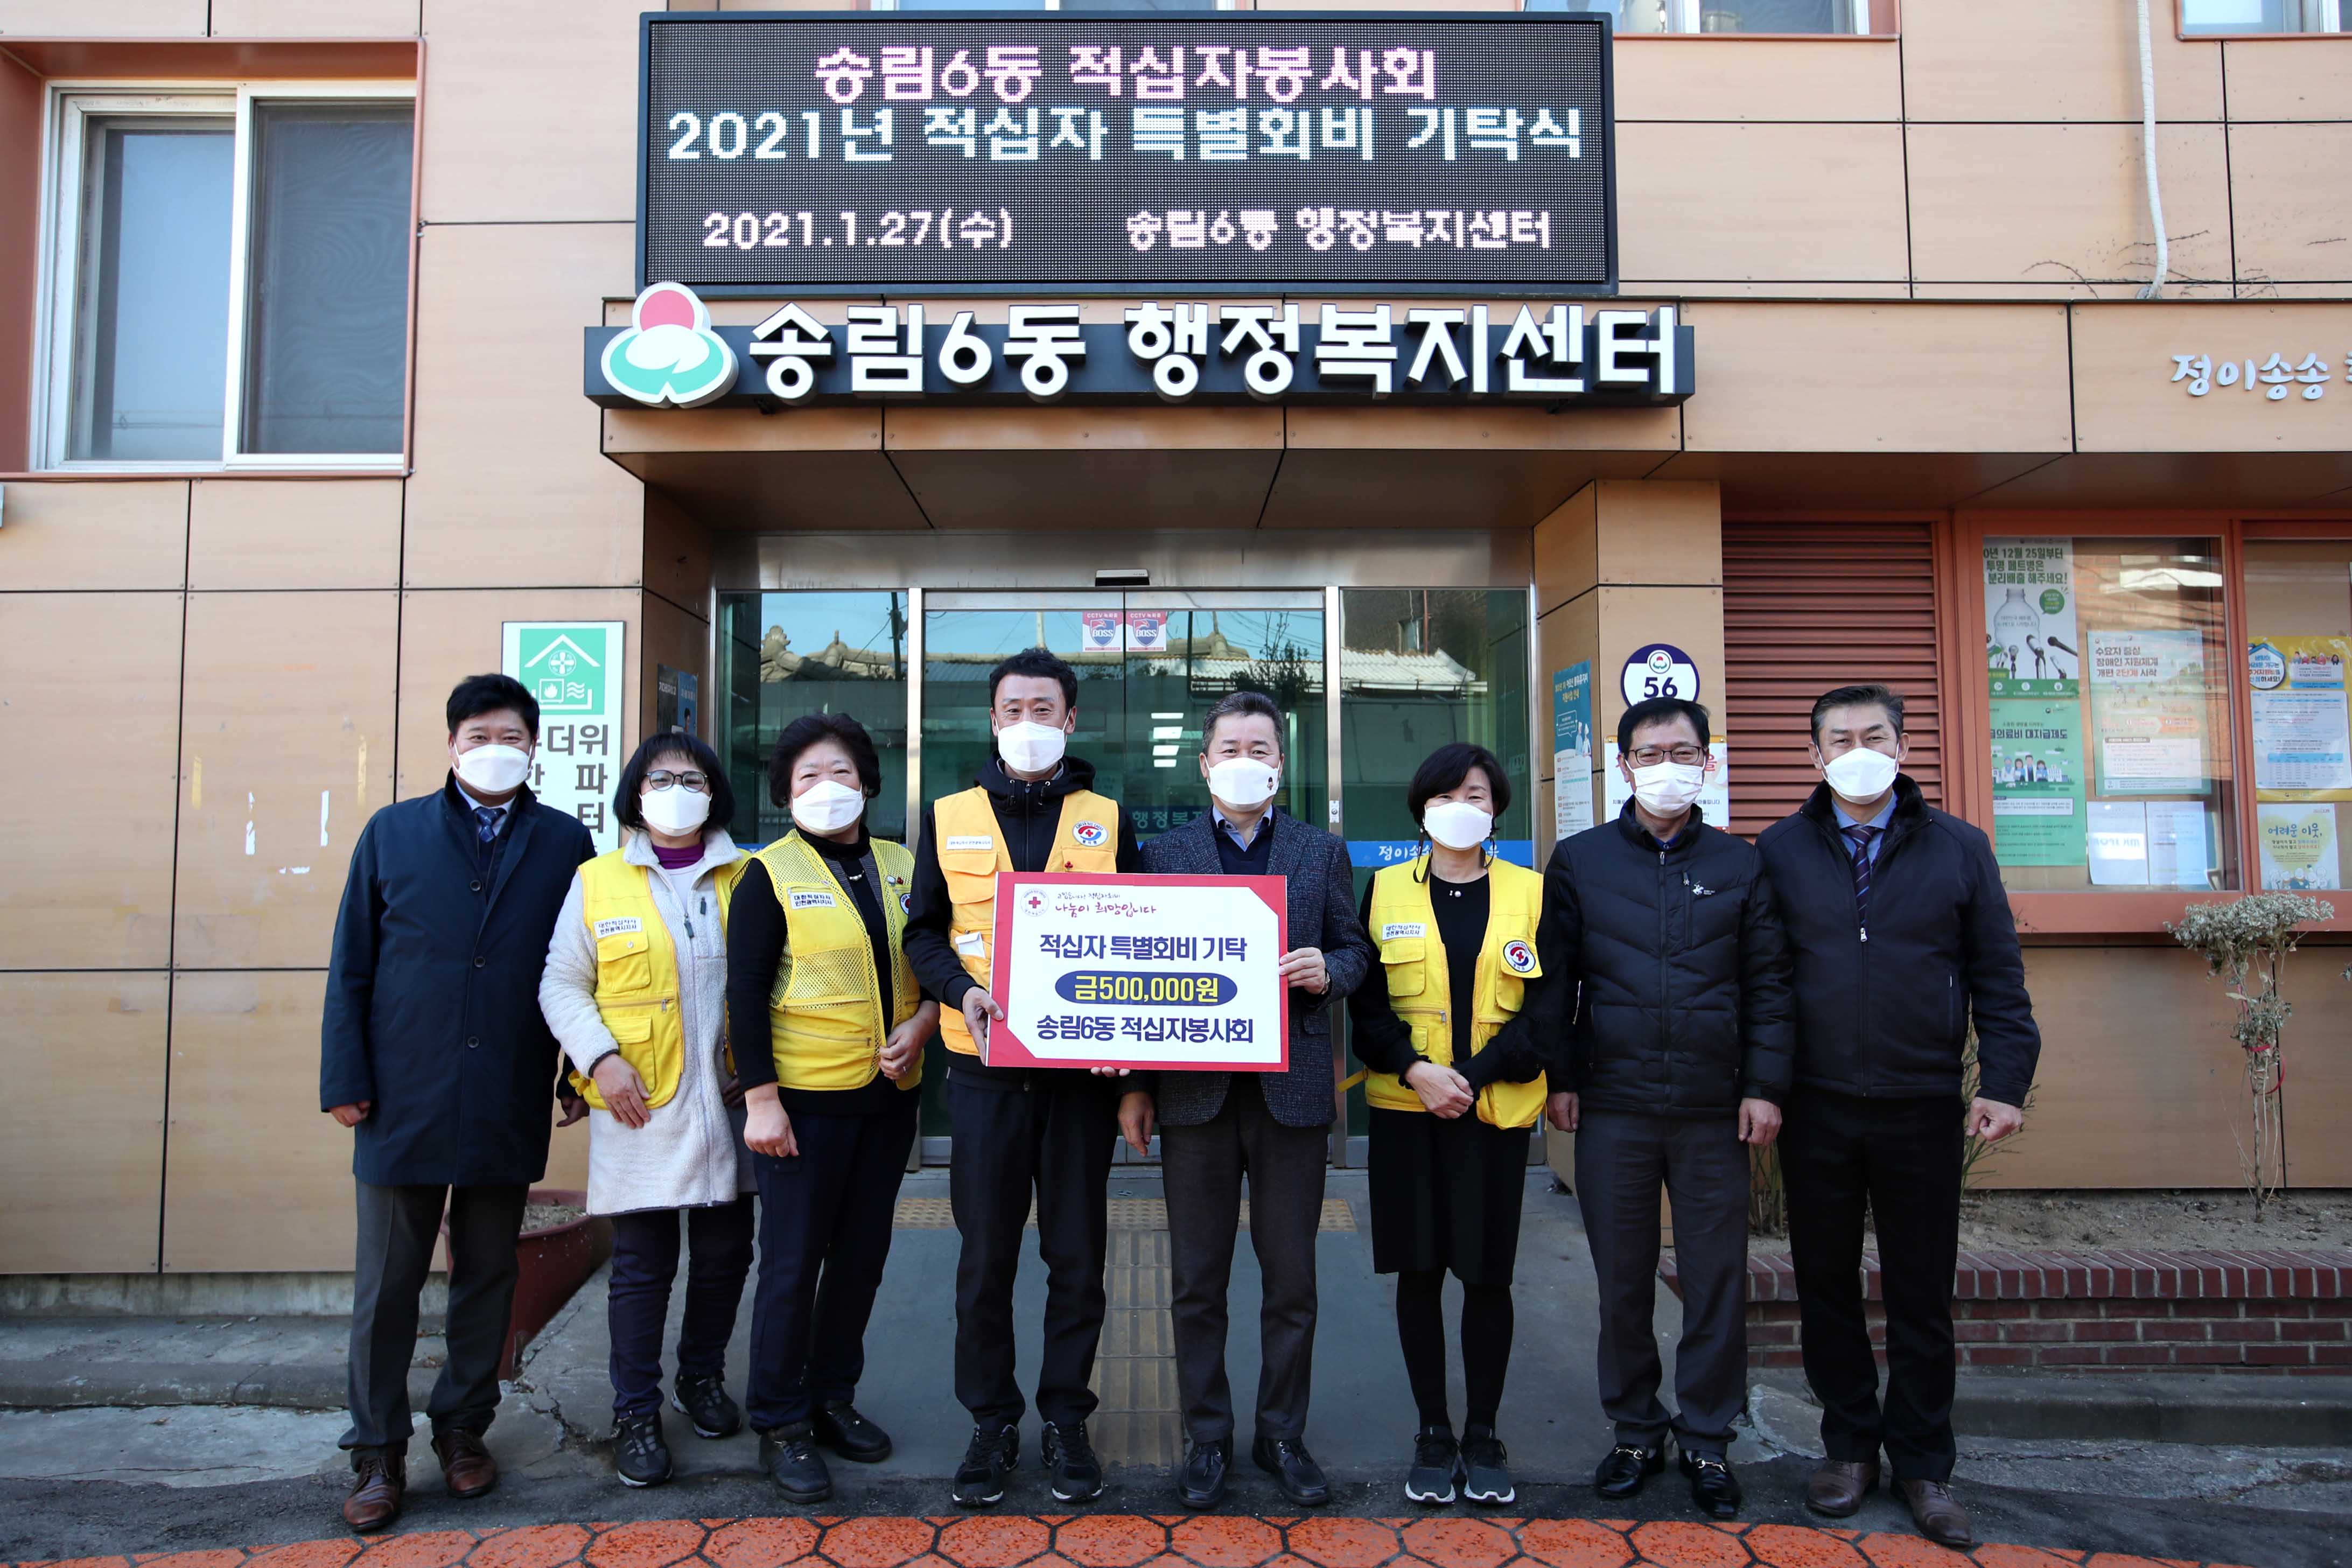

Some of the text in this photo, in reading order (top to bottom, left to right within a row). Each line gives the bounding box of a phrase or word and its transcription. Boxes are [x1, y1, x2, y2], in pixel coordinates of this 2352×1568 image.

[815, 45, 1437, 103] 송림6동 적십자봉사회
[668, 108, 1582, 162] 2021년 적십자 특별회비 기탁식
[703, 208, 1551, 251] 2021.1.27(수) 송림6동 행정복지센터
[748, 302, 1677, 401] 송림6동 행정복지센터
[2171, 353, 2330, 400] 정이송송
[1987, 560, 2044, 571] 투명 페트병은
[2002, 548, 2022, 559] 12월
[2025, 548, 2063, 559] 25일부터
[1988, 572, 2067, 584] 분리배출 해주세요!
[2096, 647, 2122, 655] 수요자
[2097, 658, 2122, 667] 장애인
[1644, 677, 1678, 698] 56
[533, 724, 608, 755] 더위
[2025, 729, 2067, 739] 대지급제도
[2268, 823, 2322, 838] 어려운 이웃,
[1055, 902, 1157, 918] 나눔이 희망입니다
[1040, 934, 1248, 961] 적십자 특별회비 기탁
[1074, 976, 1219, 1003] 금500,000원
[1037, 1015, 1253, 1043] 송림6동 적십자봉사회
